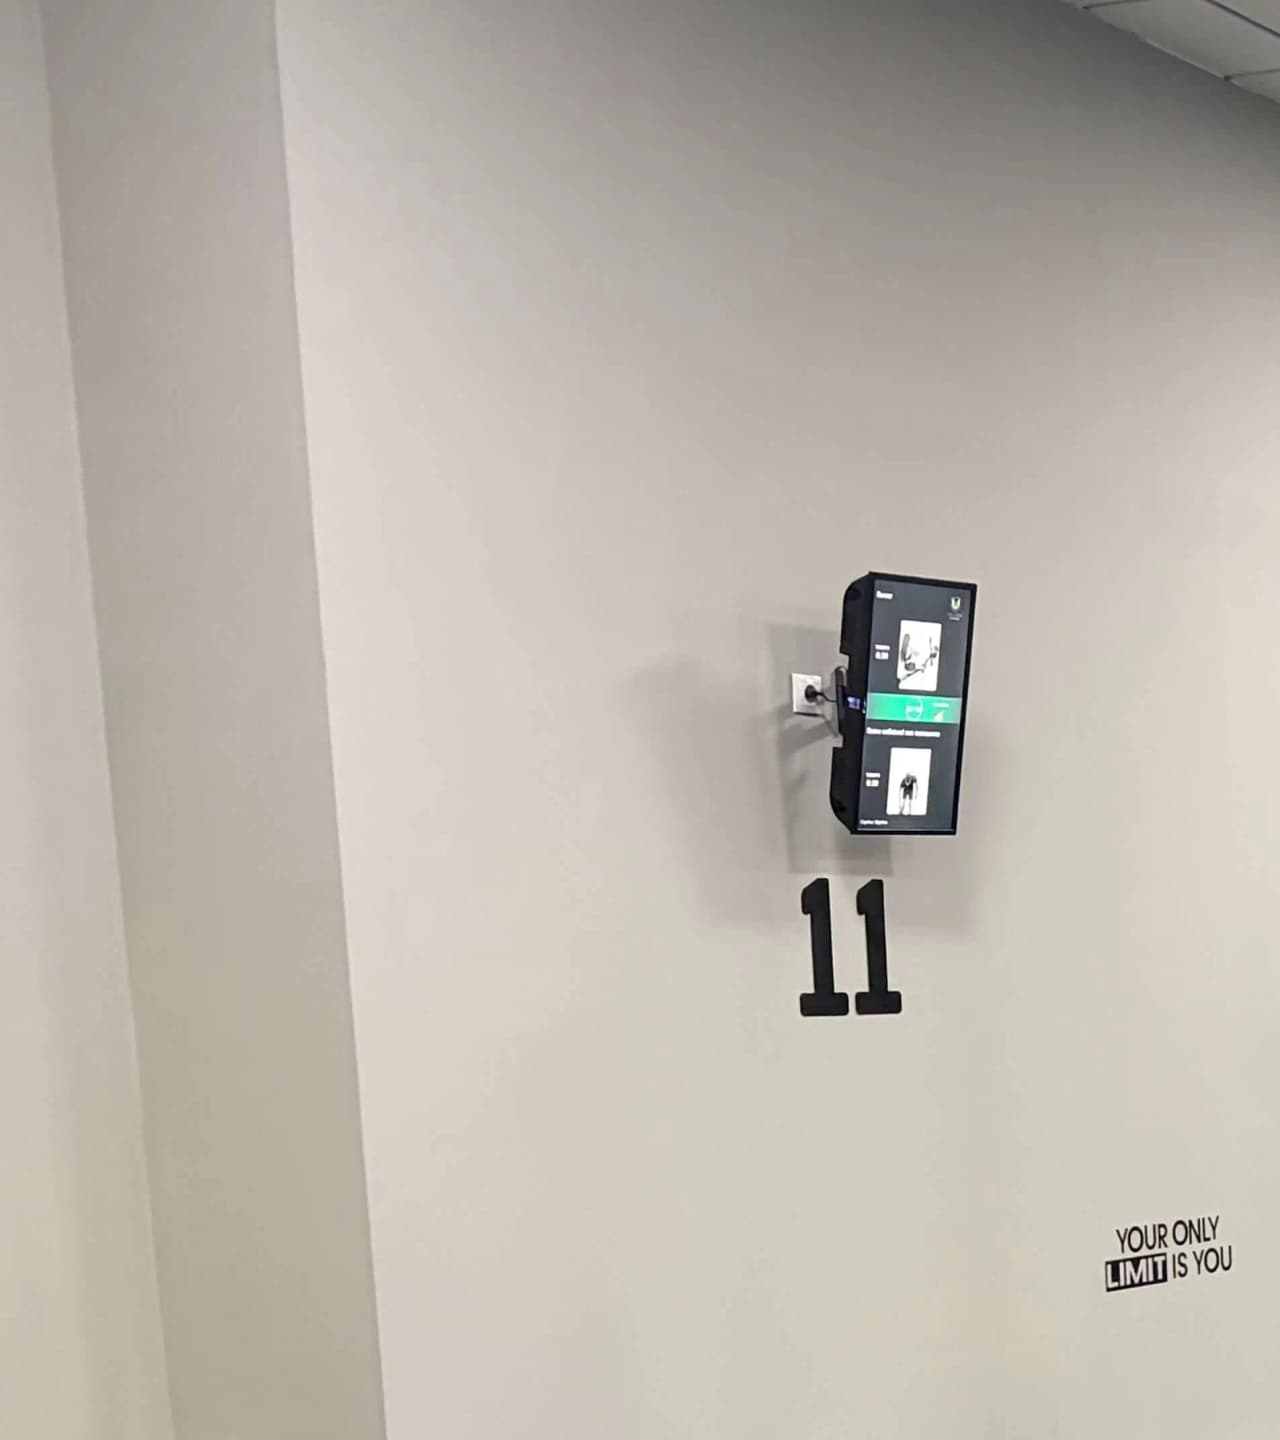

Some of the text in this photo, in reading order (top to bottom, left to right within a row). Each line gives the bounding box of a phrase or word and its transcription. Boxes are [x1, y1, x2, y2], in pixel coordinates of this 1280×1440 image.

[800, 878, 902, 1016] 11
[1116, 1215, 1219, 1254] YOUR ONLY
[1106, 1245, 1232, 1289] LIMIT IS YOU
